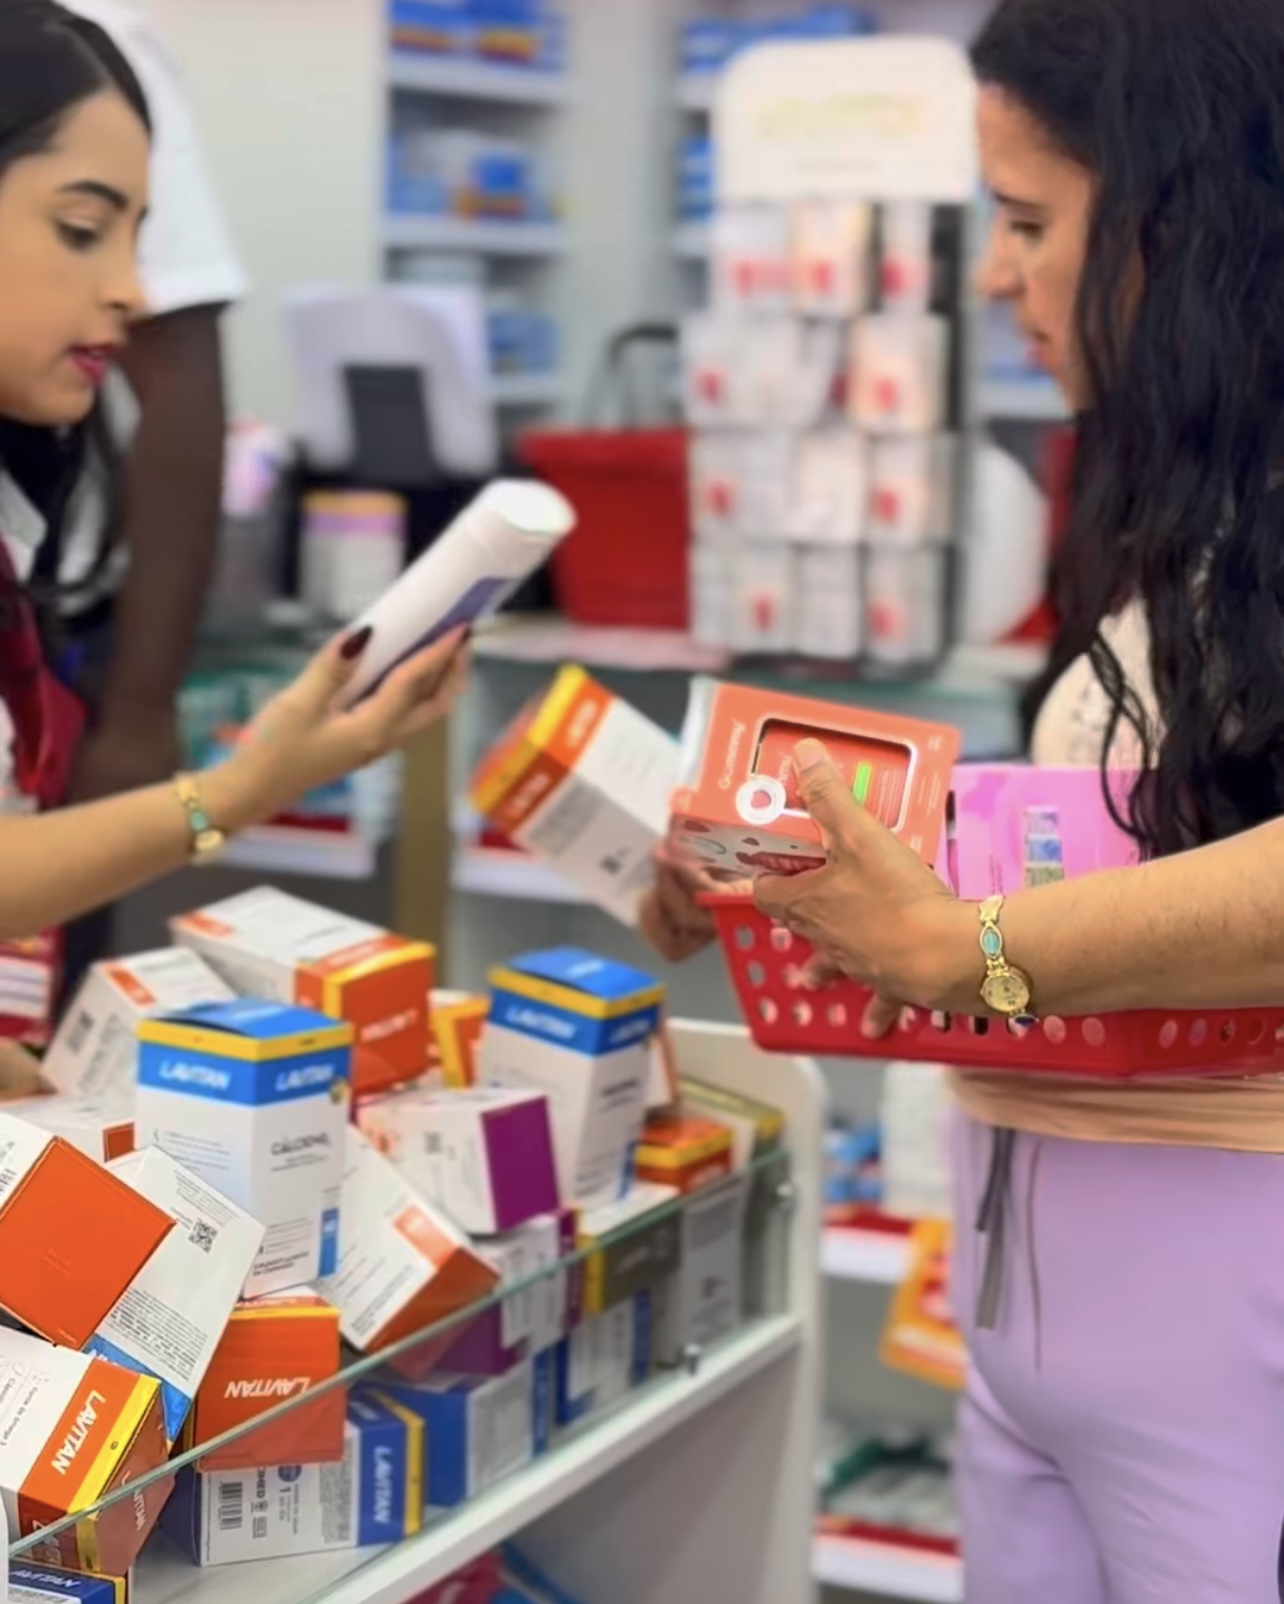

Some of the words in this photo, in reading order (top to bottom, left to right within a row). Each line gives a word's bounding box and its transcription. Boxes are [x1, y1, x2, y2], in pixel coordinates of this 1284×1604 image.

[225, 1376, 311, 1399] LAVITAN
[51, 1390, 106, 1475] LAVITAN
[373, 1445, 393, 1525] LAVITAN
